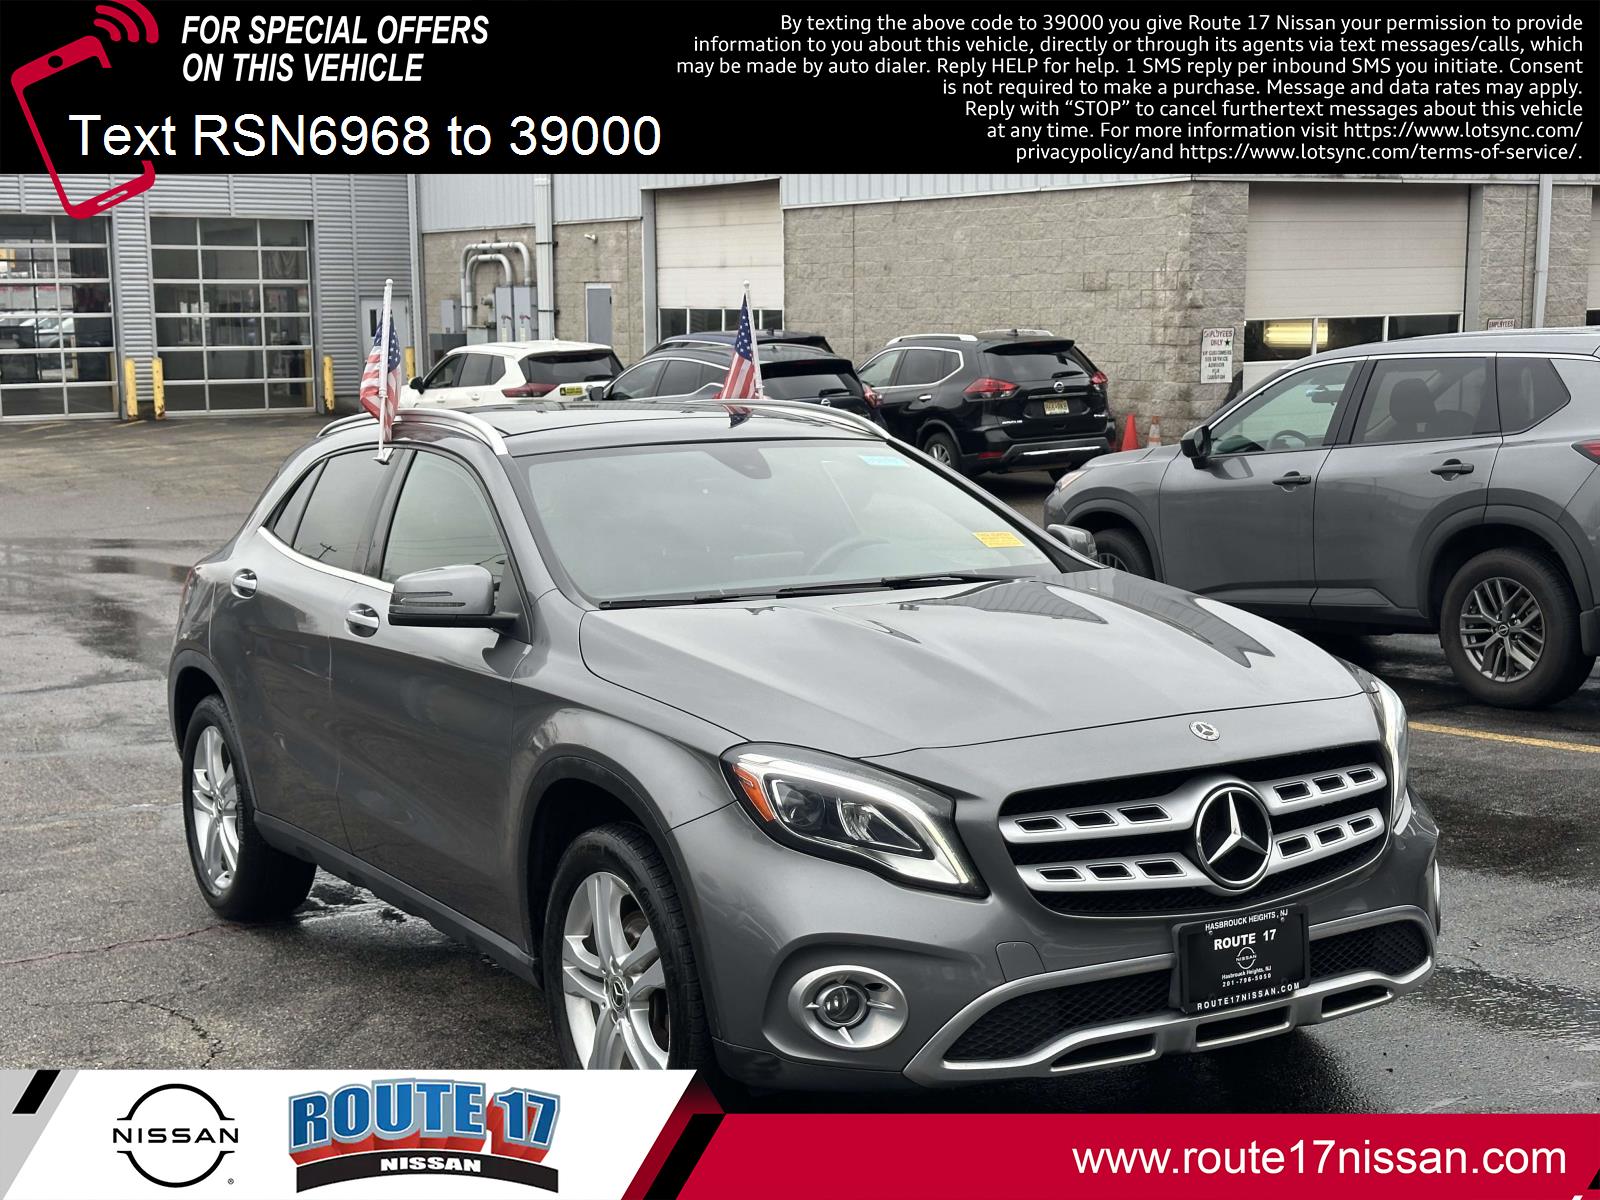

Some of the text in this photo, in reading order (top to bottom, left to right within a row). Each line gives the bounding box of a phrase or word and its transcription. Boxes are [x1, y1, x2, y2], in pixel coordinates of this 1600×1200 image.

[1205, 918, 1247, 932] HASBROUCK
[1280, 908, 1289, 917] NJ
[1214, 928, 1277, 951] ROUTE 17
[1236, 954, 1257, 962] NISSAN
[1197, 982, 1300, 1011] ROUTE17NISSAN.COM
